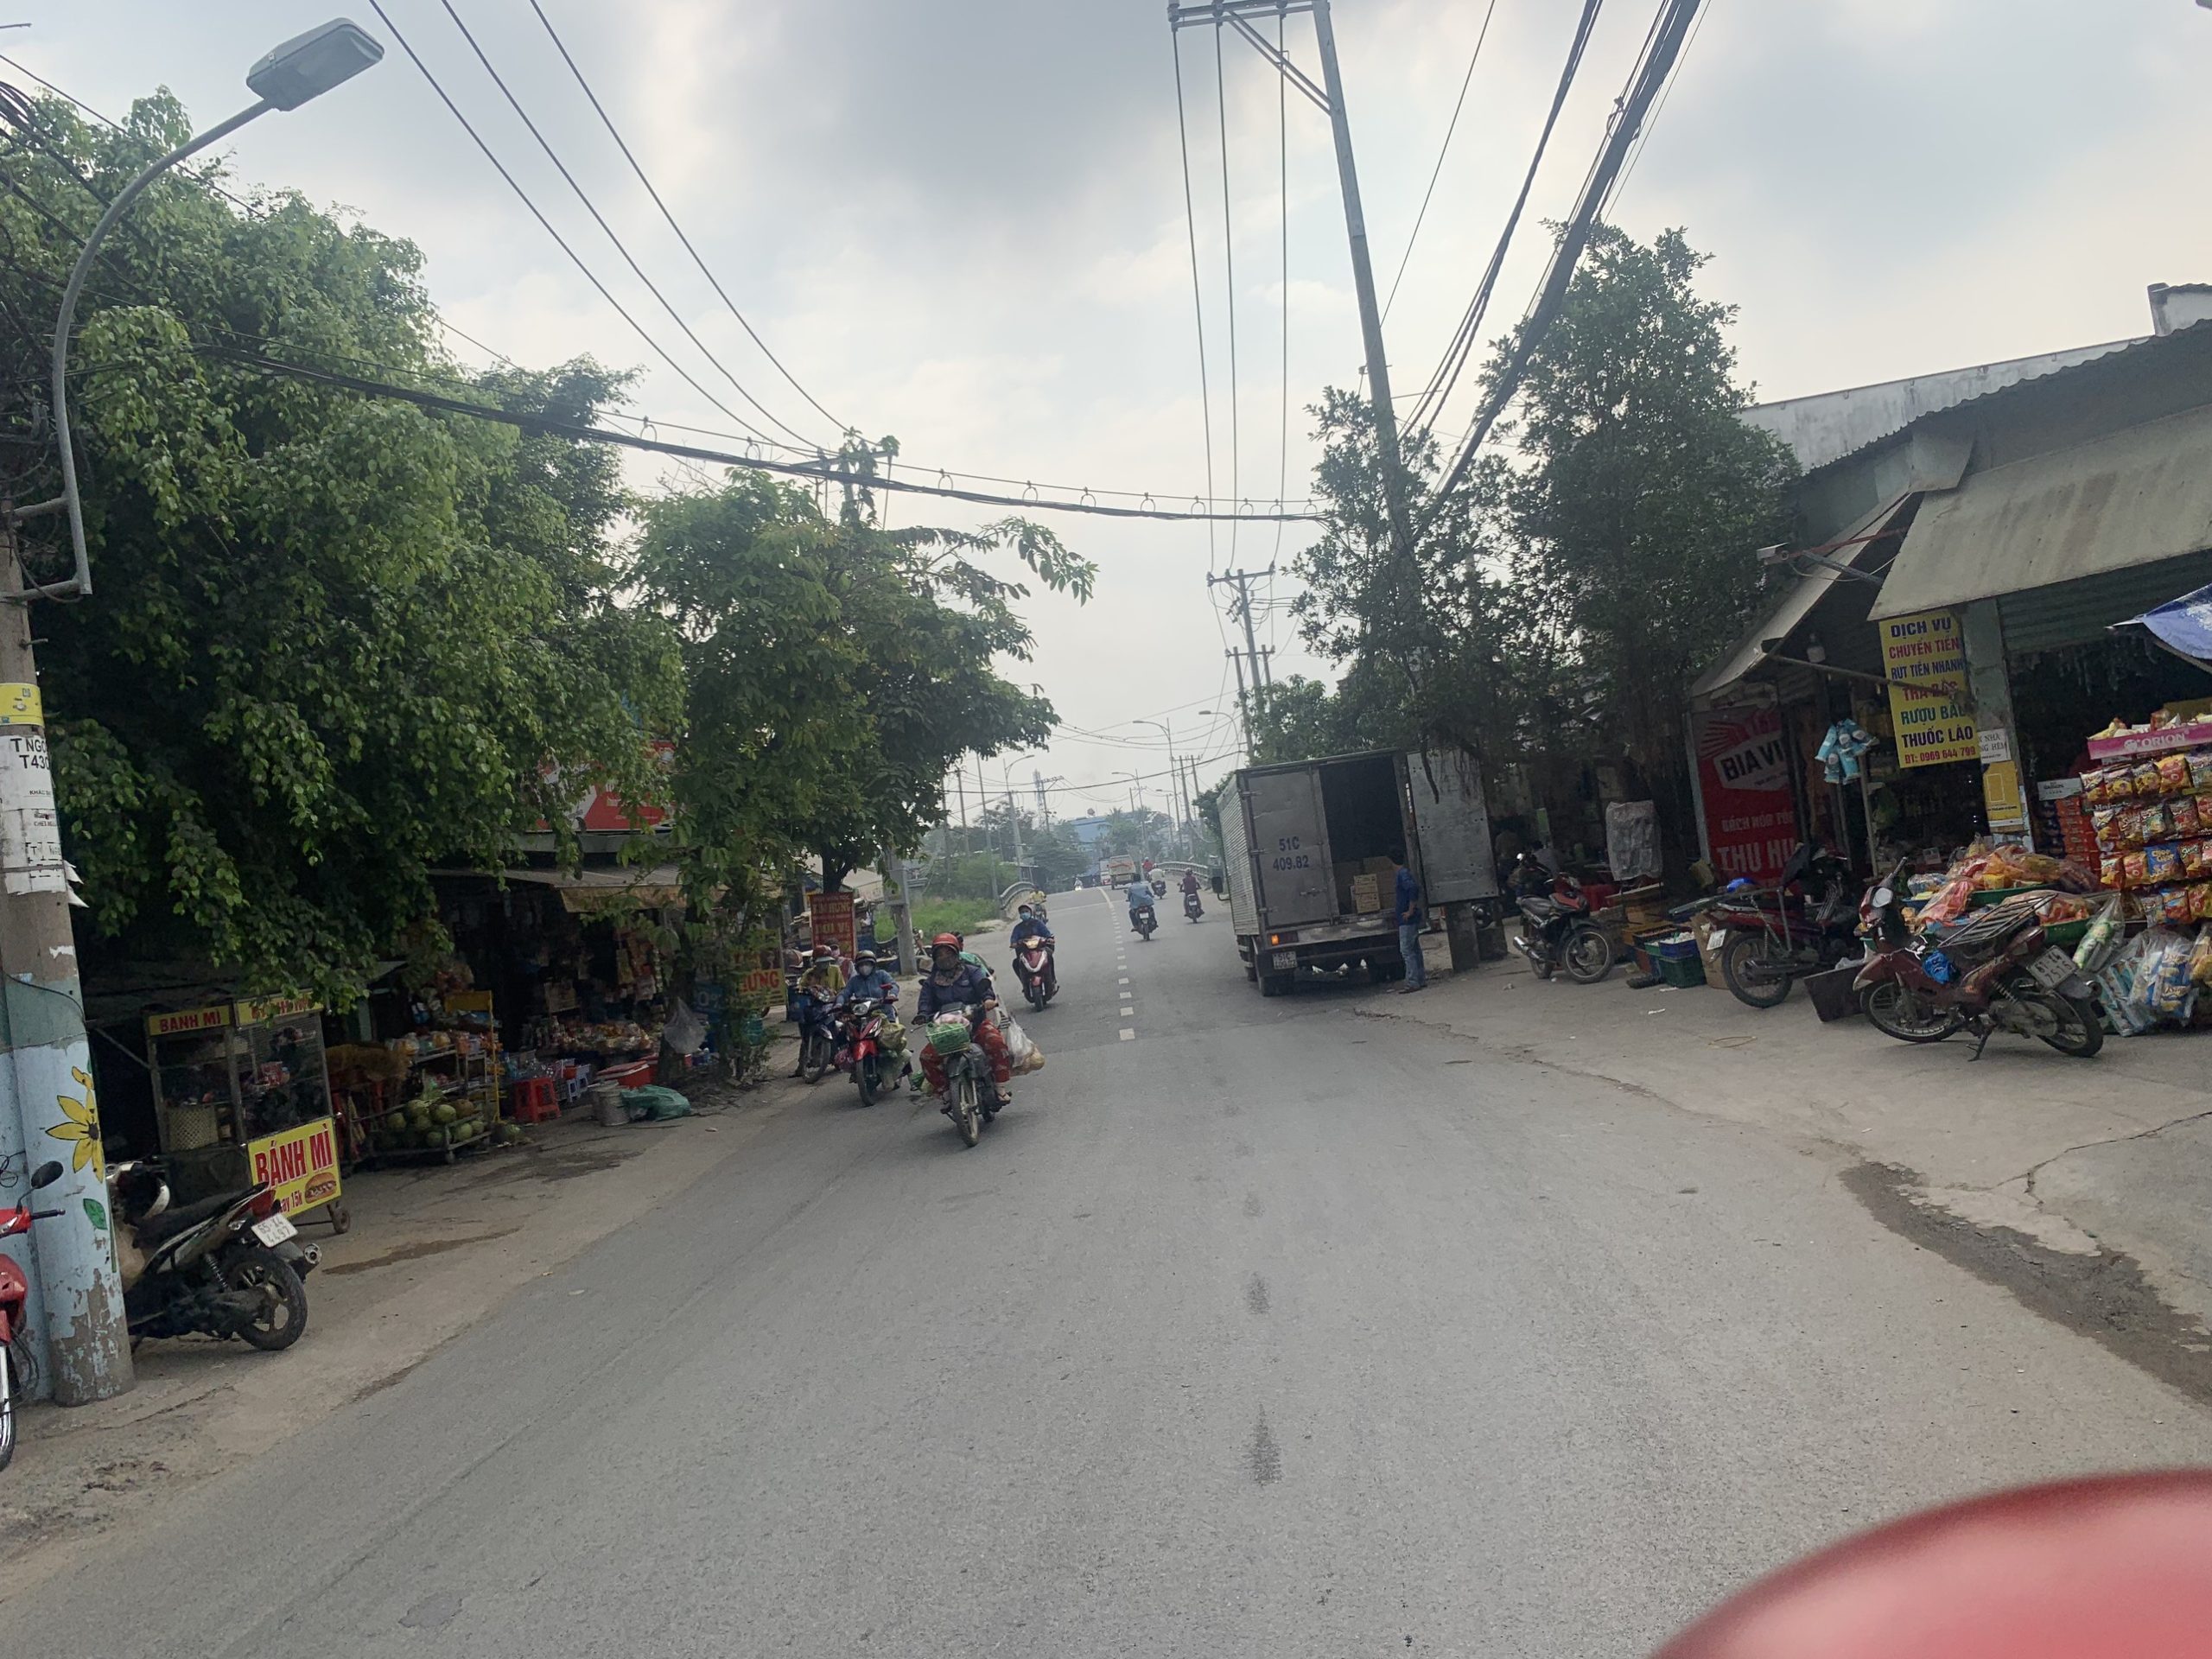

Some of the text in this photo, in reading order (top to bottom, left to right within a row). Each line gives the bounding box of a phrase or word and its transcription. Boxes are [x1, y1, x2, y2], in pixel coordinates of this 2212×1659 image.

[1890, 617, 1951, 639] DỊCH VỤ
[1932, 658, 1965, 674] NHANH
[1900, 707, 1936, 726] RƯỢU
[1901, 725, 1945, 748] THUỐC
[2141, 732, 2185, 748] ORION
[1920, 750, 1941, 763] 0969
[1942, 748, 1958, 760] 644
[1960, 746, 1976, 757] 799
[1720, 748, 1763, 781] BIA
[1279, 836, 1300, 852] 51C
[1273, 855, 1309, 871] 409.82
[1717, 841, 1763, 873] THU
[254, 1123, 334, 1188] BÁNH MÌ
